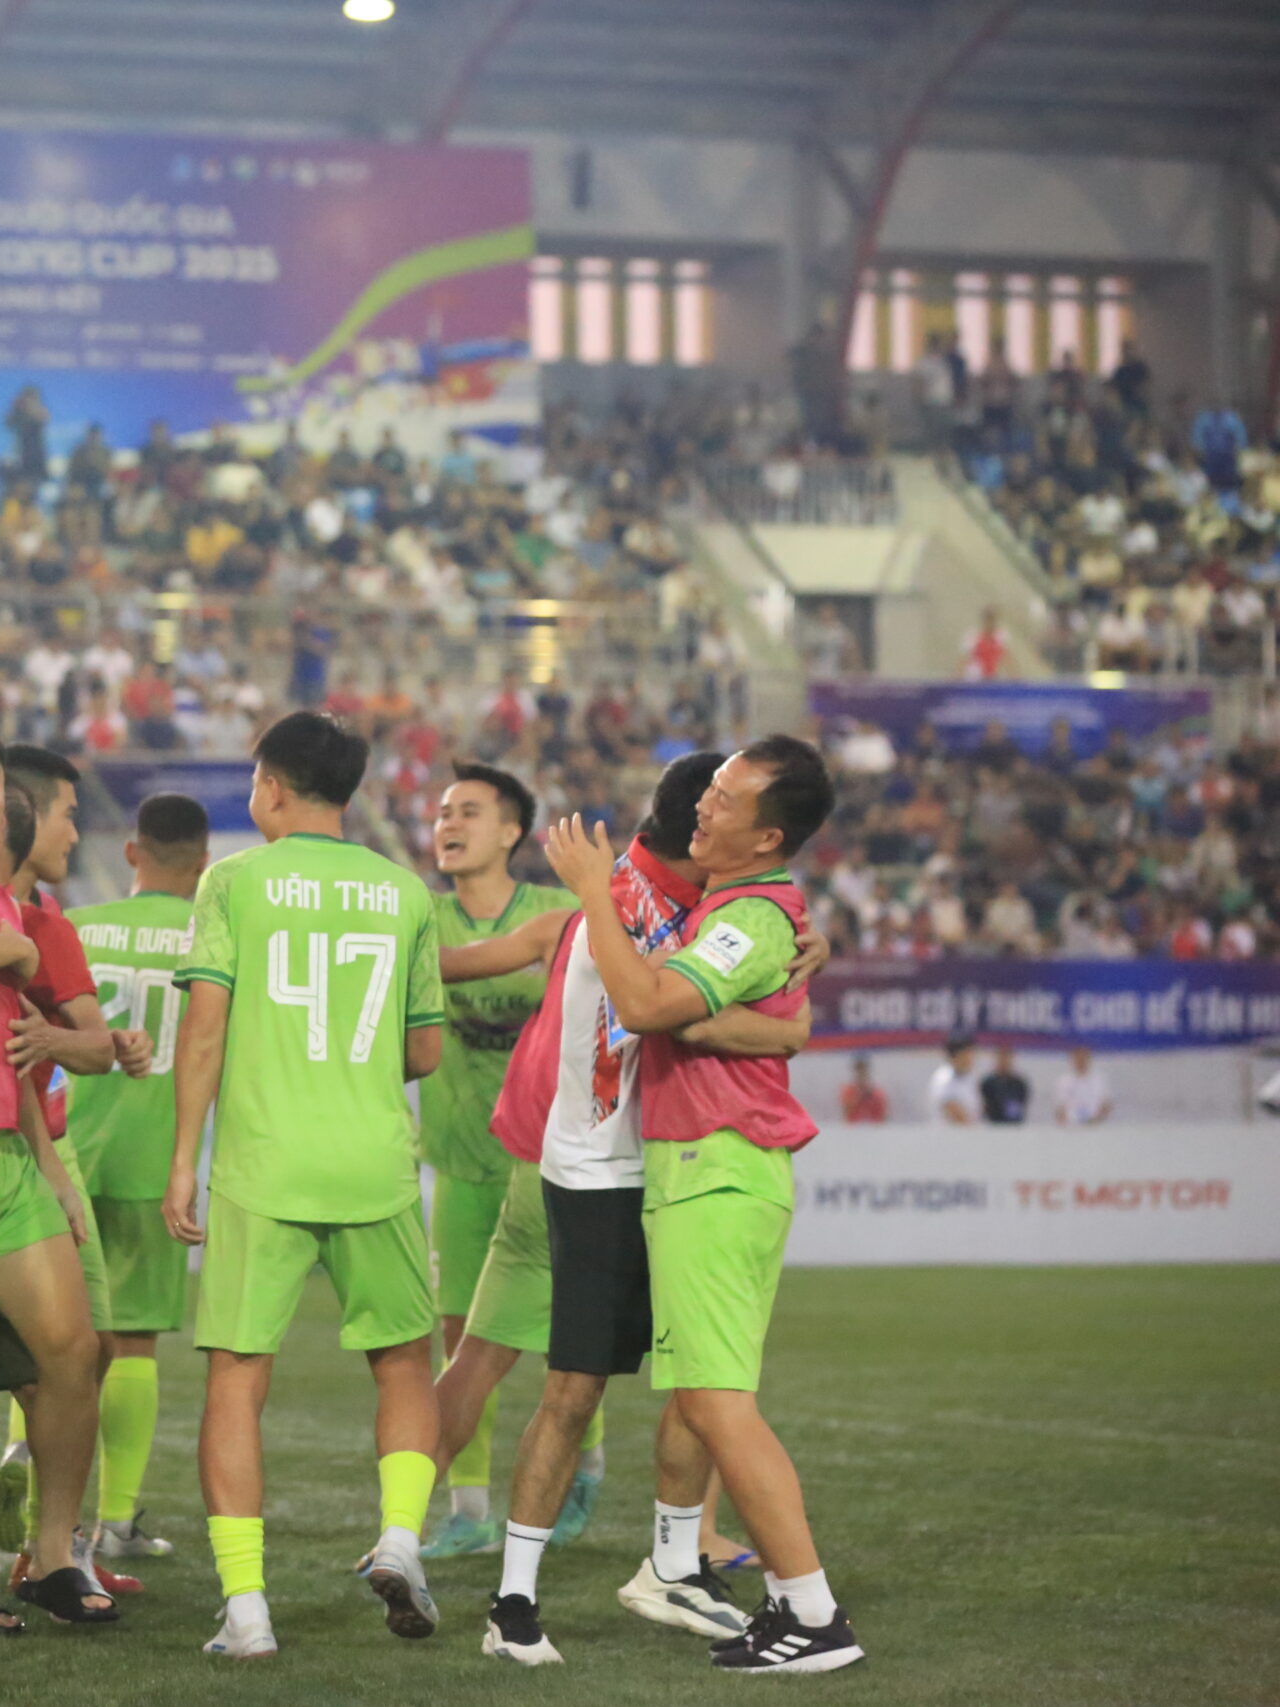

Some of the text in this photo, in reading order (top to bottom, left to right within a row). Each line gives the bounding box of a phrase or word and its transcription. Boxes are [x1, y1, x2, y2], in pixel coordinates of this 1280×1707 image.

[88, 240, 176, 279] CUP
[266, 872, 400, 917] VĂN THÁI
[79, 923, 130, 952] MINH
[267, 930, 397, 1064] 47
[89, 963, 181, 1075] 20
[815, 1178, 1232, 1211] HYUNDAI TC MOTOR
